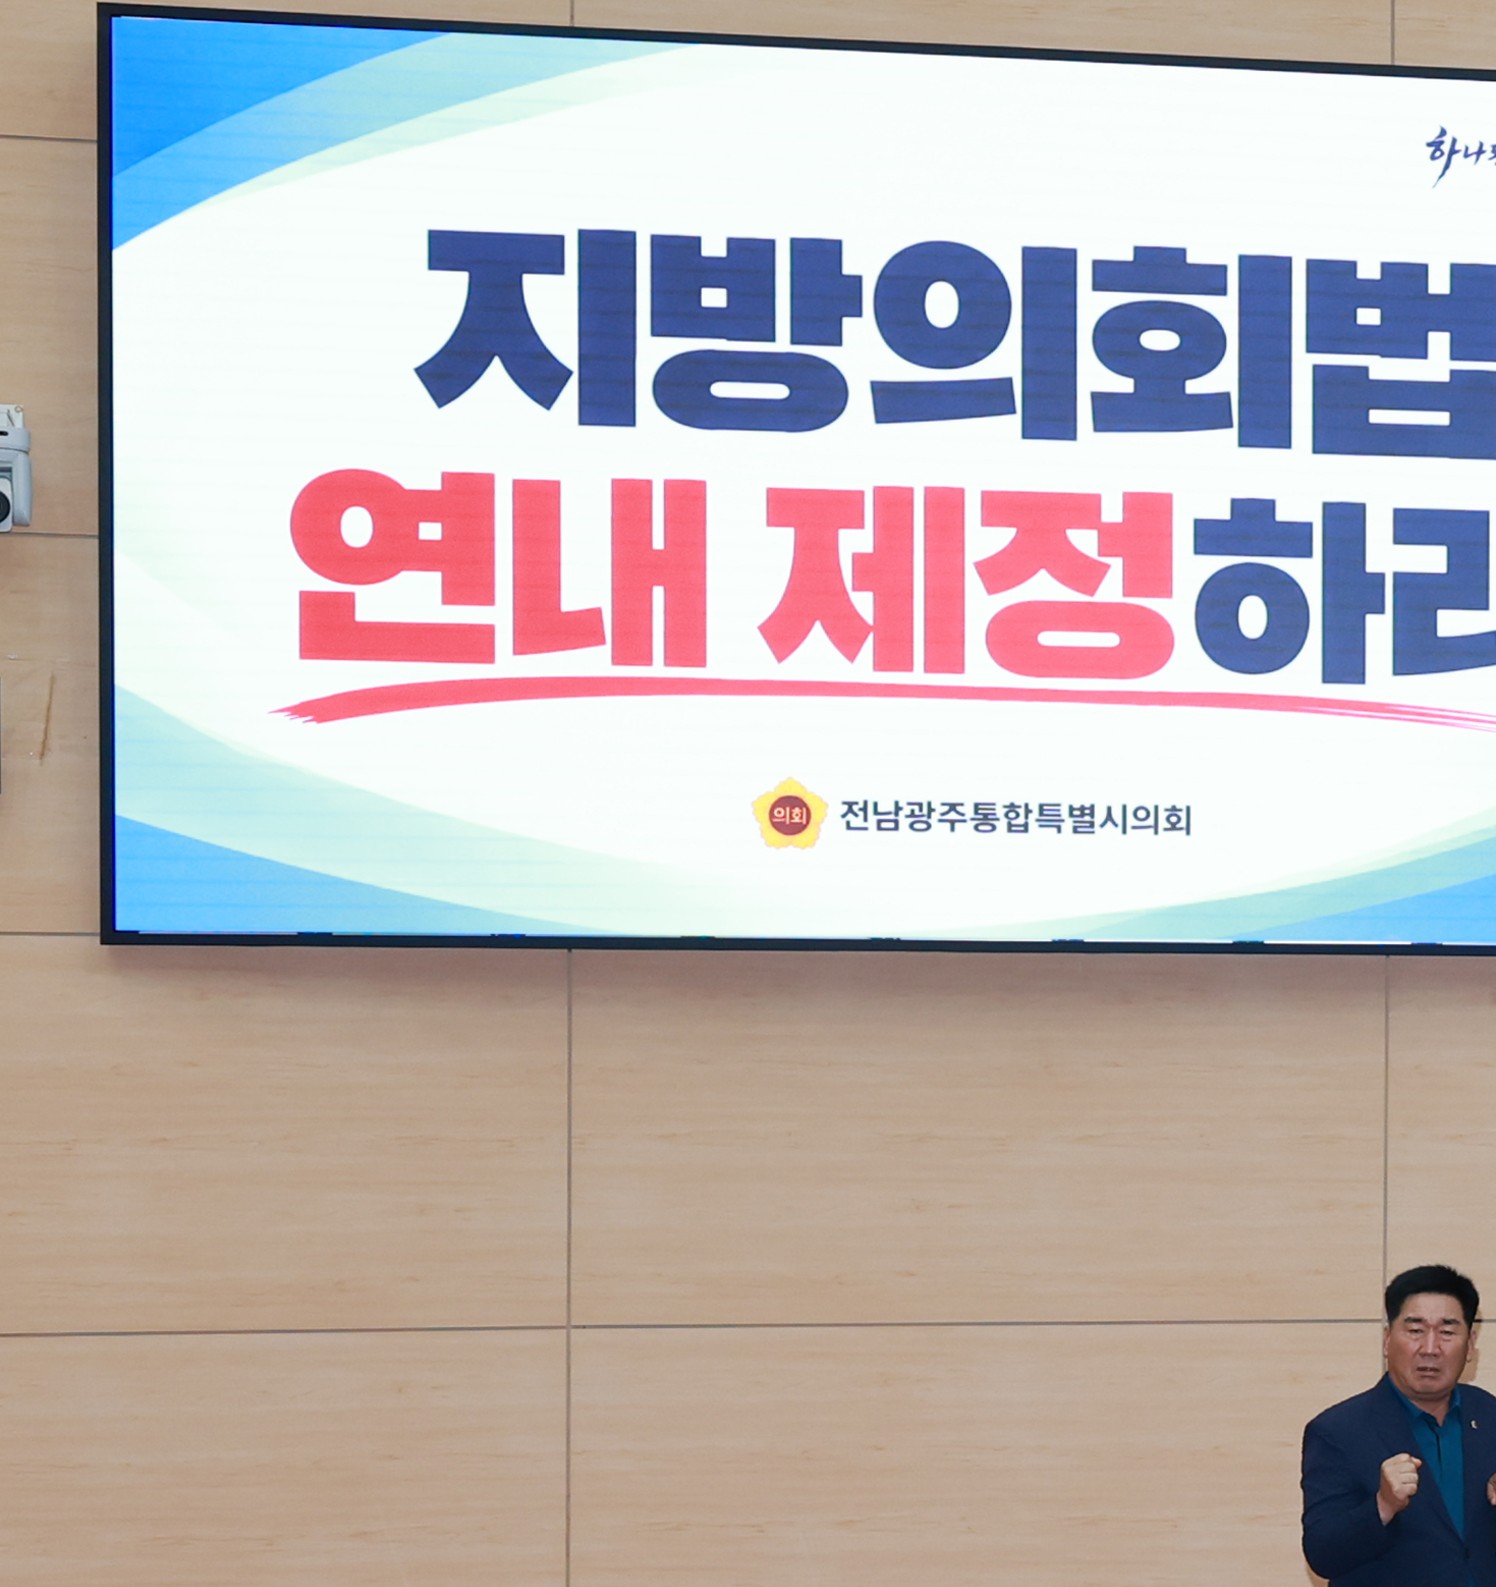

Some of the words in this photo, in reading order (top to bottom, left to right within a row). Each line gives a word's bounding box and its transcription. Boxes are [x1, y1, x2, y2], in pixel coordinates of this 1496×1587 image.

[289, 468, 708, 671] 연내
[772, 806, 808, 826] 의회
[840, 799, 1192, 836] 전남광주통합특별시의회
